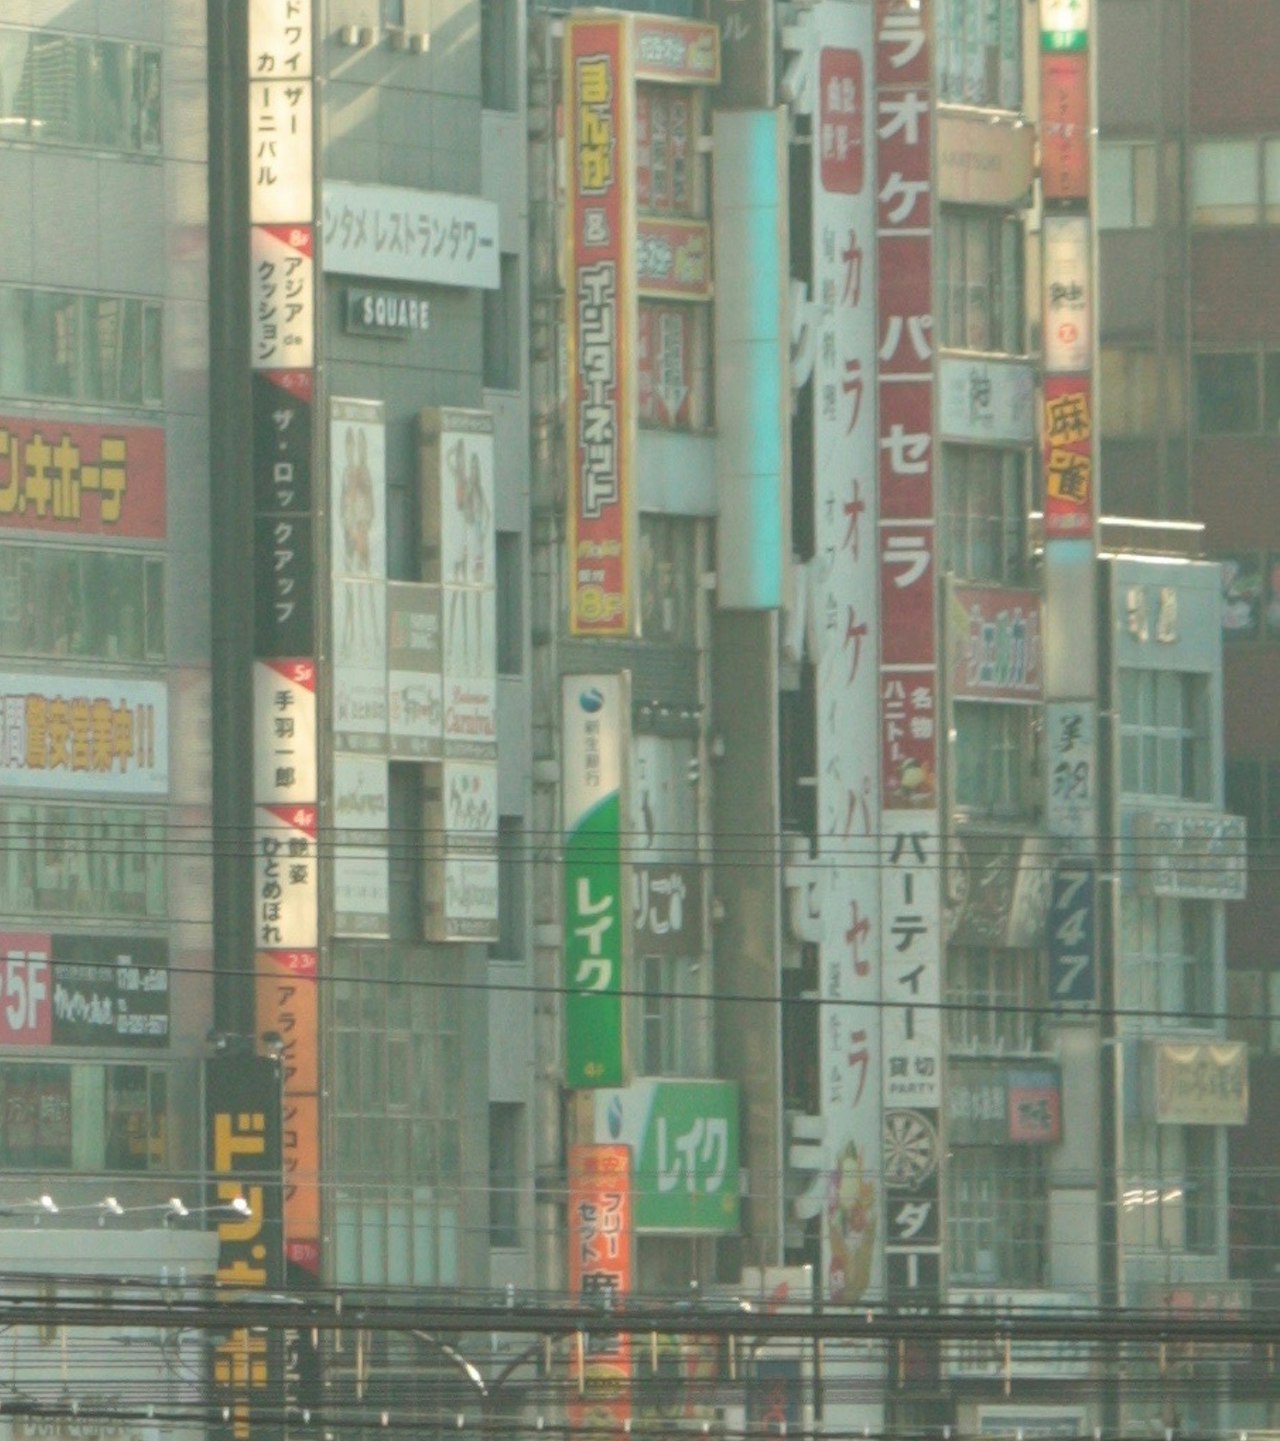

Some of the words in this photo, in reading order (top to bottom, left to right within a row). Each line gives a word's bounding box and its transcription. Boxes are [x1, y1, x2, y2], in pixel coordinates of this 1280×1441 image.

[256, 53, 278, 188] カーニバル
[256, 260, 277, 360] クッション
[363, 294, 430, 330] SQUARE
[880, 312, 931, 589] パセラ
[273, 408, 295, 624] ザ・ロックアップ
[274, 689, 295, 789] 手羽一郎
[573, 877, 615, 997] レイク
[1055, 870, 1091, 997] 747
[5, 950, 48, 1031] 5F
[888, 1082, 935, 1097] PARTY
[656, 1112, 729, 1193] レイク
